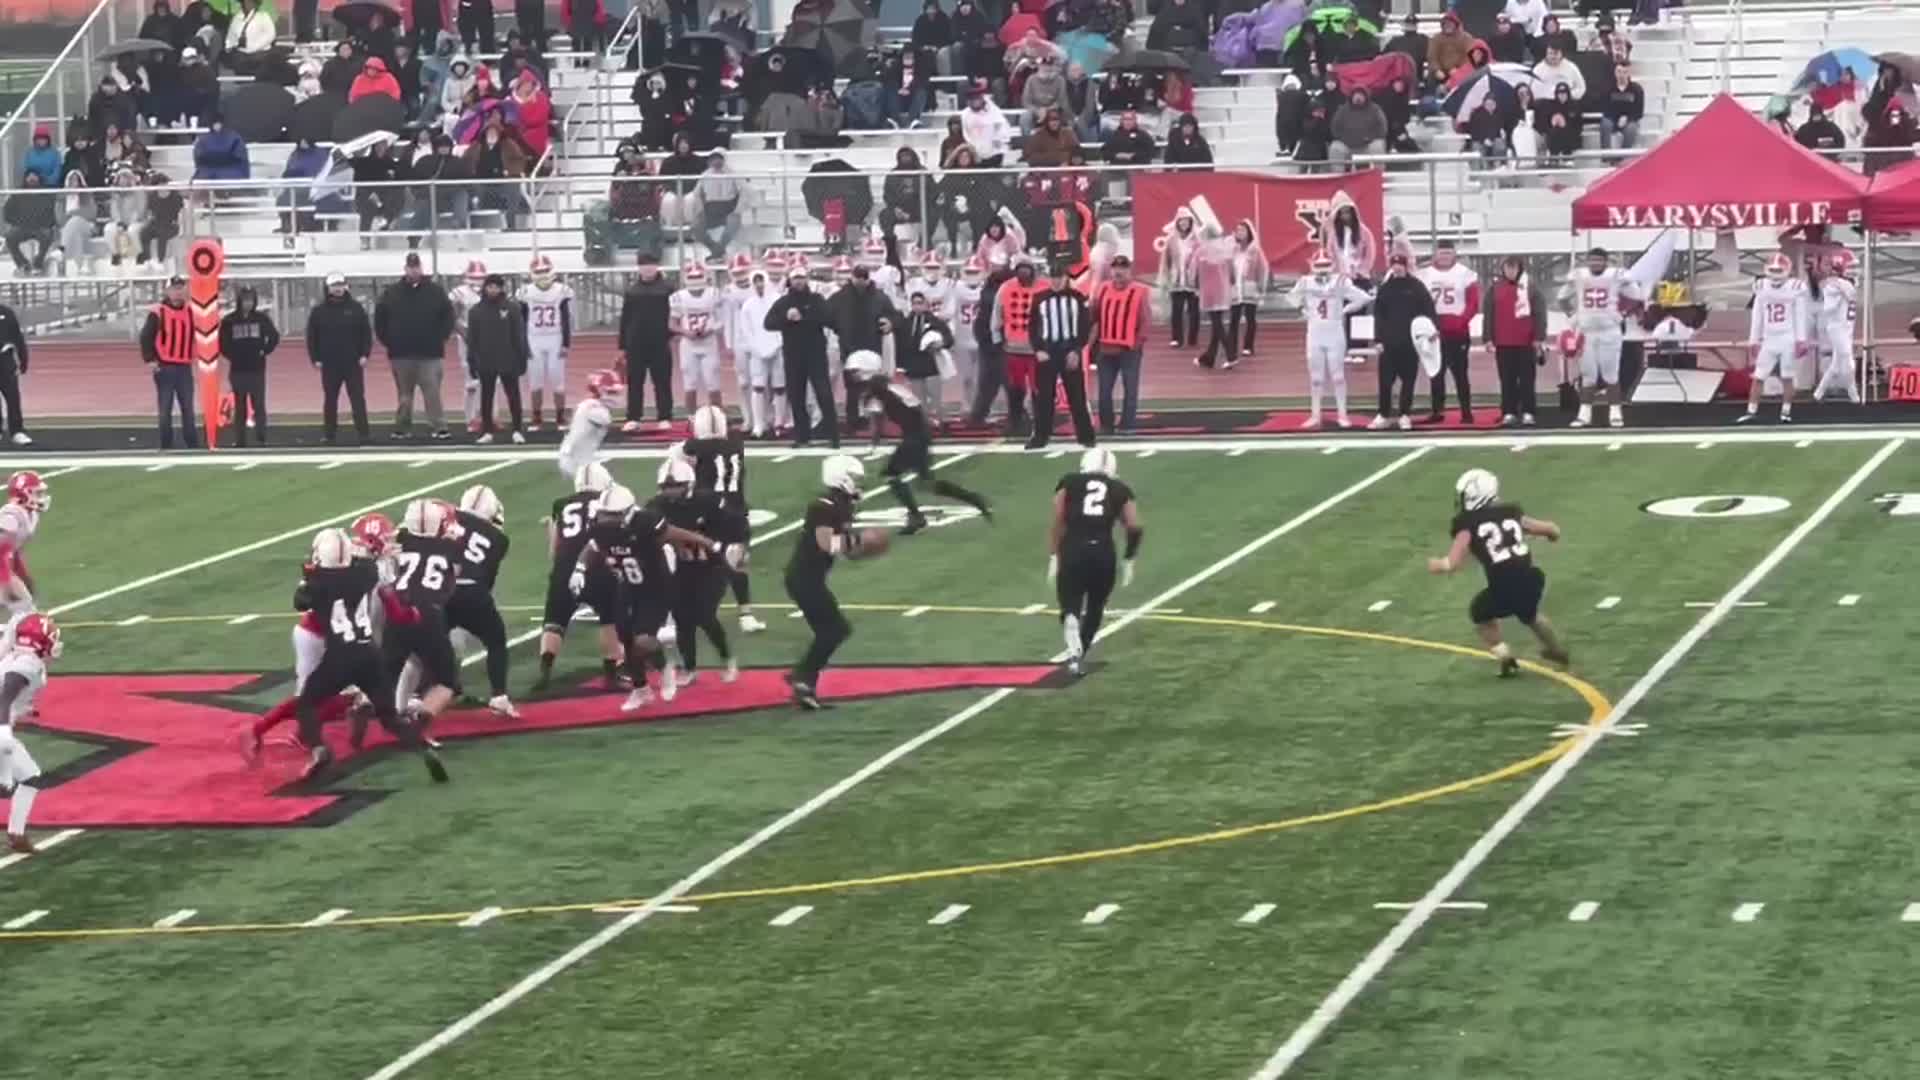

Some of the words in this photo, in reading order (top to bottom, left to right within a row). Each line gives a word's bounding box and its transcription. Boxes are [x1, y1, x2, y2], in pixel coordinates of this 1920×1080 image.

[1052, 207, 1068, 241] 1
[1608, 201, 1831, 227] MARYSVILLE
[1317, 298, 1328, 320] 4
[1431, 287, 1455, 305] 75
[1584, 288, 1608, 308] 52
[533, 306, 556, 328] 33
[1767, 303, 1786, 323] 12
[1892, 372, 1918, 396] 40
[714, 453, 741, 493] 11
[1083, 480, 1107, 516] 2
[1478, 519, 1529, 564] 23
[398, 551, 446, 591] 76
[331, 594, 373, 642] 44
